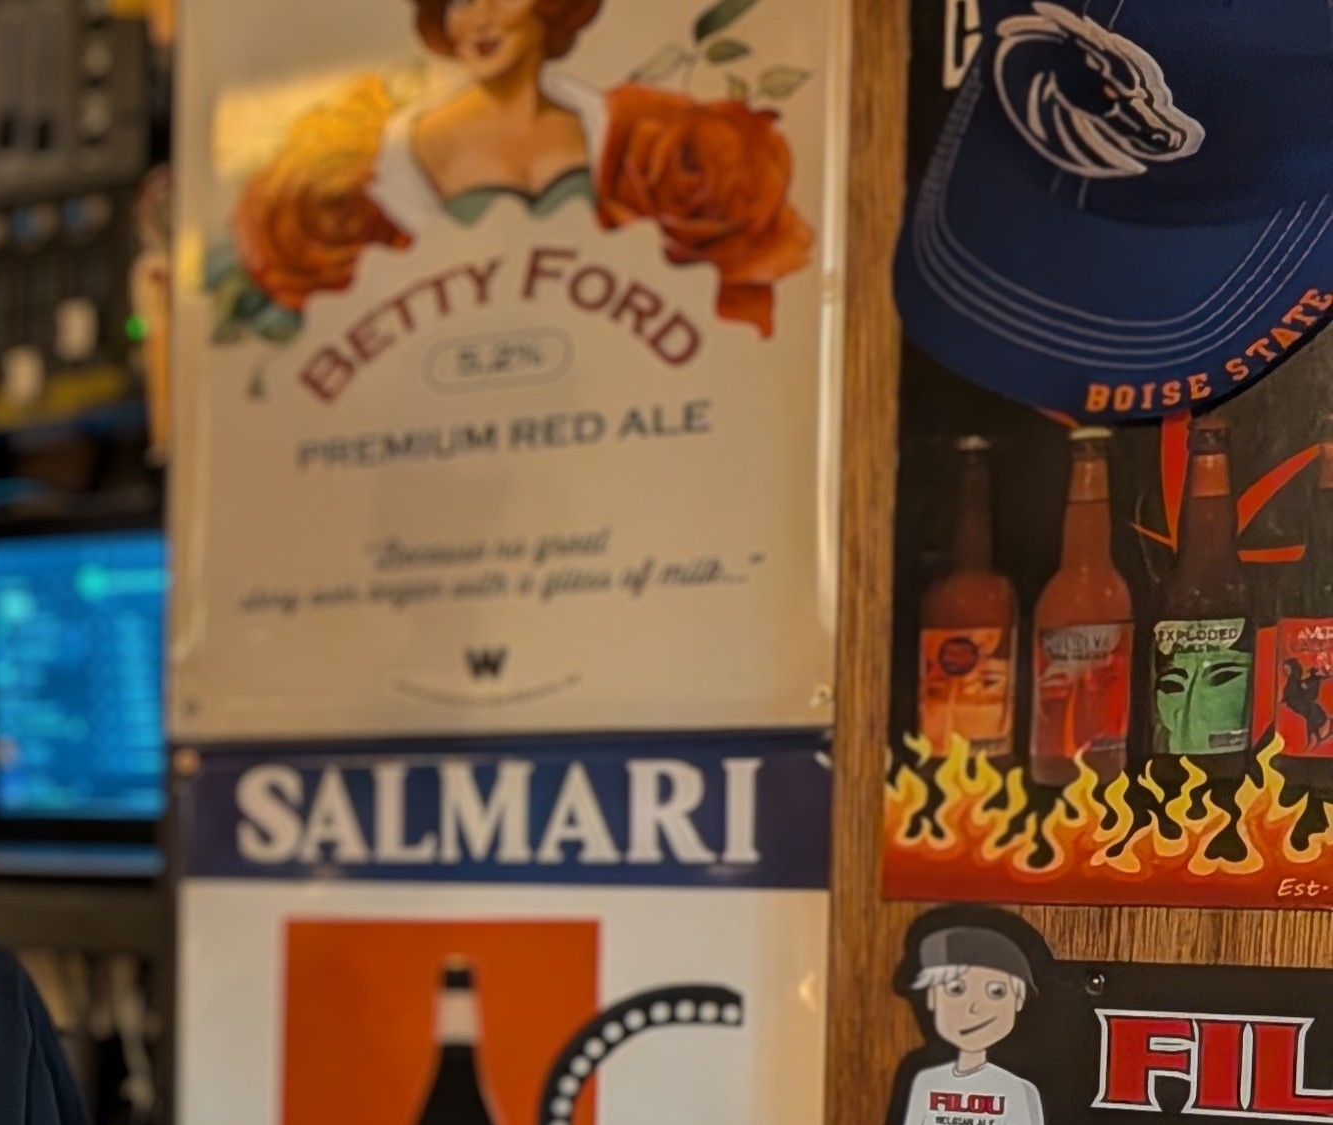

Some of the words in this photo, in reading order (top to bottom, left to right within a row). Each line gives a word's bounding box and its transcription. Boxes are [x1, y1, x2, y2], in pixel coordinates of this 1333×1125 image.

[298, 254, 501, 405] BETTY
[519, 246, 703, 368] FORD
[456, 343, 546, 378] 5.2%
[1085, 372, 1211, 413] BOISE
[1225, 288, 1333, 382] STATE
[295, 420, 498, 470] PREMIUM
[508, 410, 606, 451] RED
[618, 399, 715, 438] ALE
[235, 756, 763, 866] SALMARI
[929, 1091, 1006, 1115] FILOU
